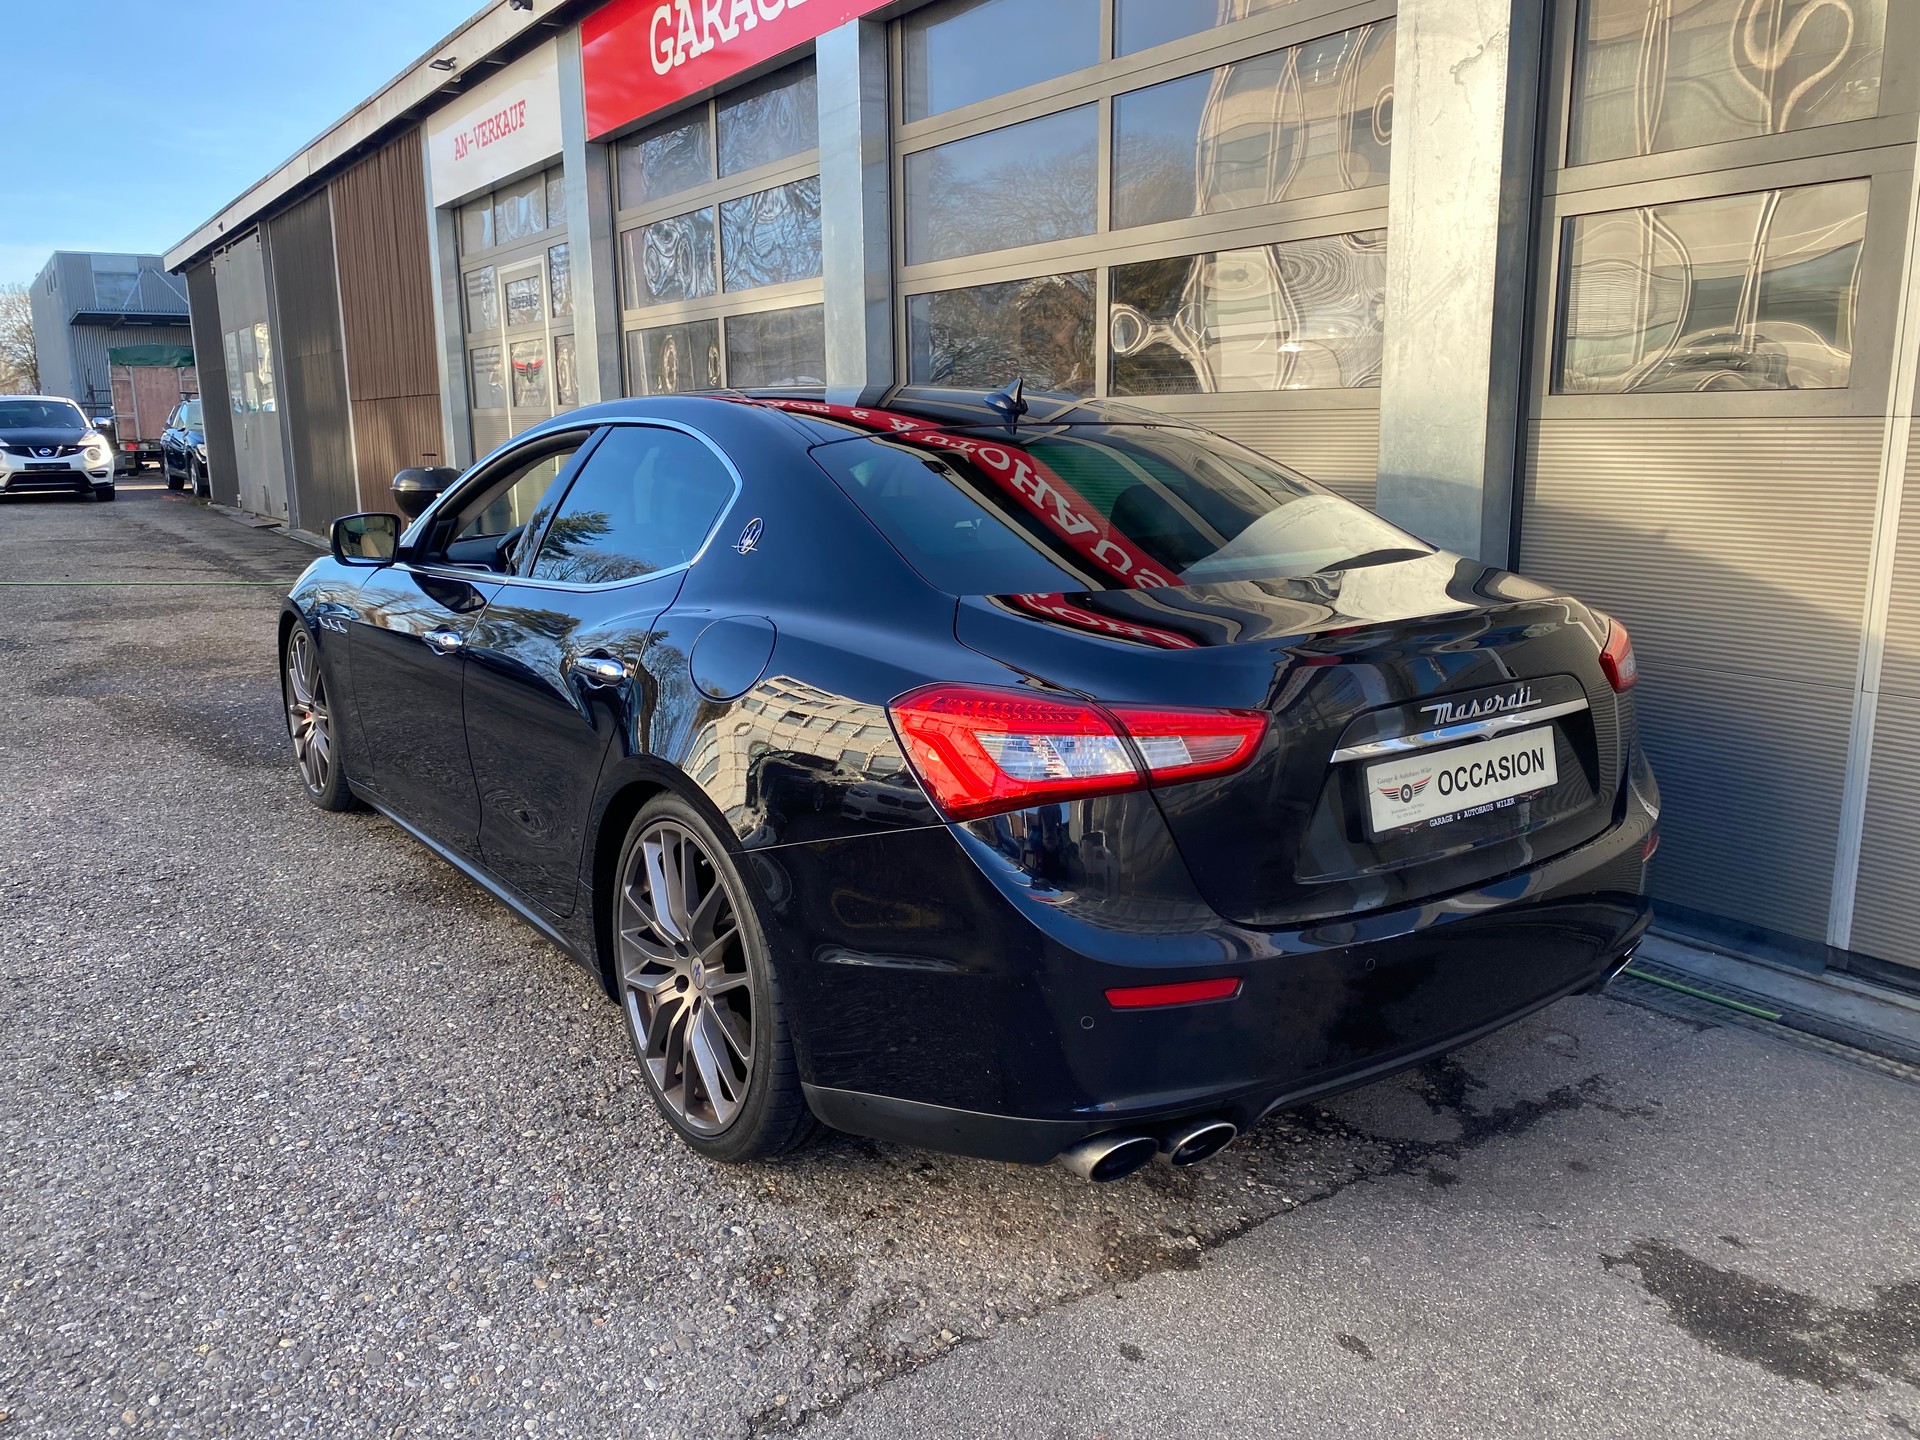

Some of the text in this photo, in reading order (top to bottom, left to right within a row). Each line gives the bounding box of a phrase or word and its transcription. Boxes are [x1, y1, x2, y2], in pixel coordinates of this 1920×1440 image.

[650, 0, 808, 75] GARA
[454, 99, 526, 161] AN-VERKAUF
[1420, 686, 1541, 725] Maserati
[1437, 747, 1545, 796] OCCASION
[1429, 814, 1454, 827] GARAGE
[1456, 812, 1461, 821] &
[1463, 803, 1494, 818] AUTOHAUS
[1496, 797, 1516, 809] WILER
